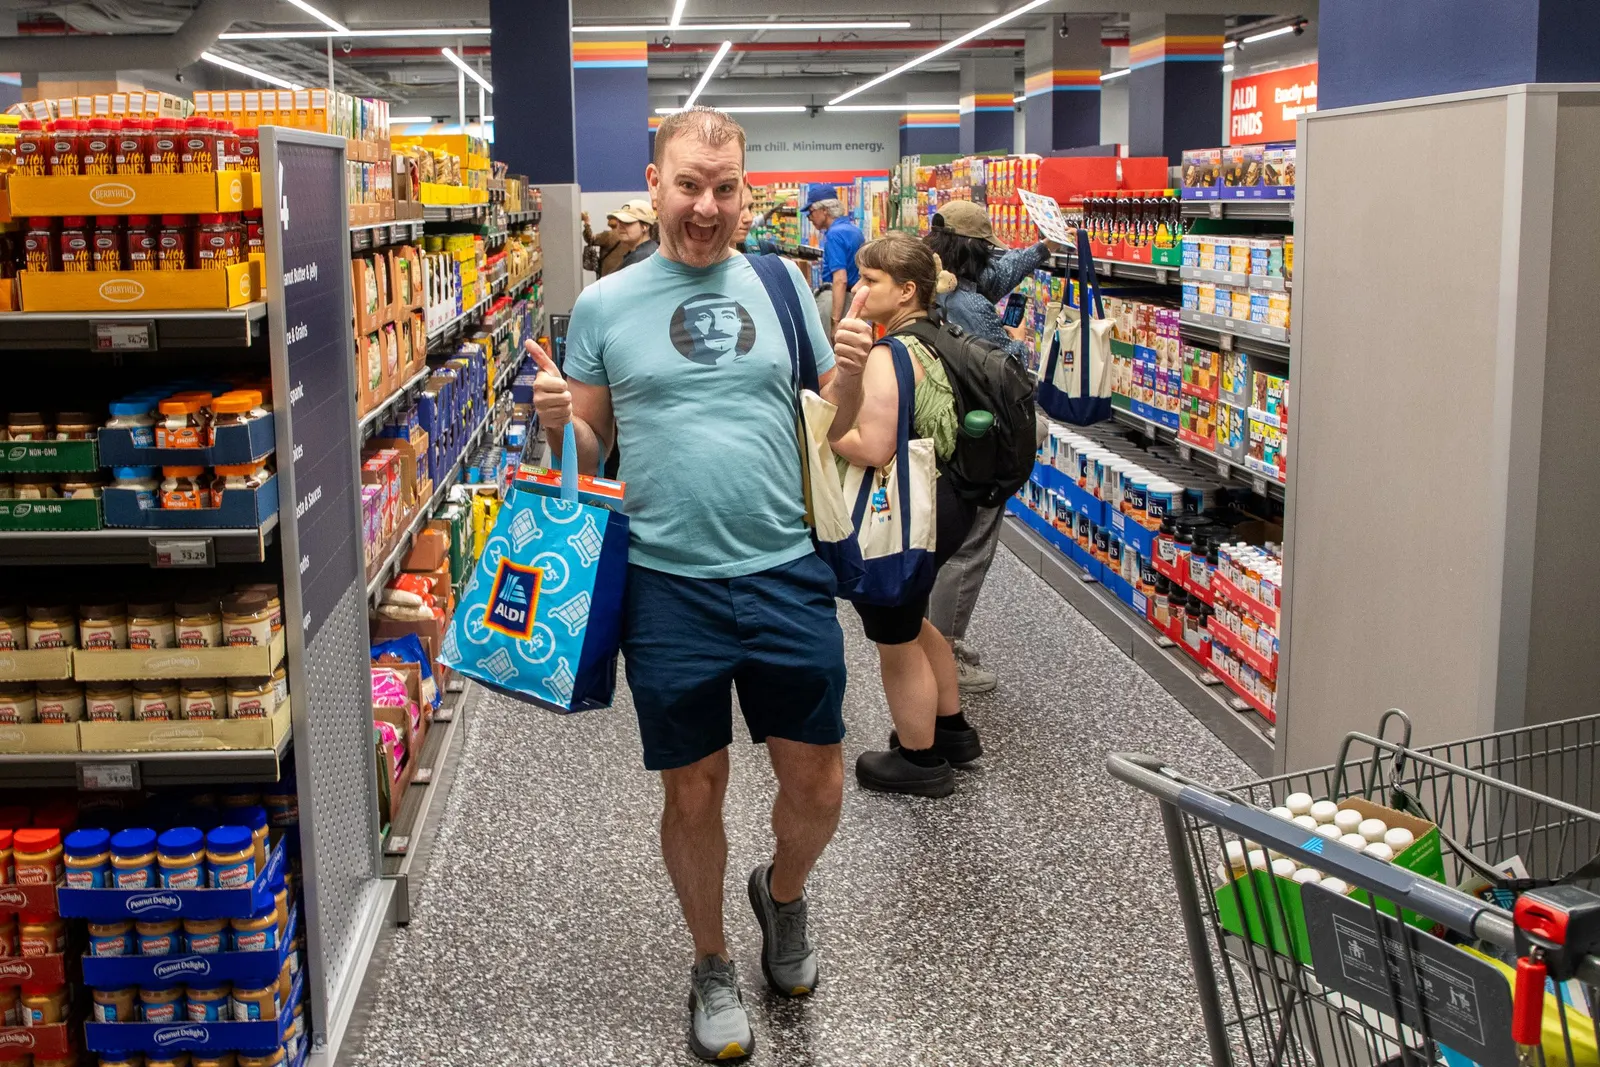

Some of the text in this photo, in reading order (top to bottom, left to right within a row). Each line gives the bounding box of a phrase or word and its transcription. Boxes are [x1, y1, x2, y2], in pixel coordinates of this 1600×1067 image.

[1232, 85, 1257, 111] ALDI
[1231, 111, 1263, 137] FINDS
[764, 142, 789, 152] chill.
[792, 141, 842, 151] Minimum
[845, 142, 885, 153] energy.
[192, 151, 212, 162] Hot
[95, 189, 130, 199] BERRYHILL
[63, 261, 89, 272] HONE
[95, 261, 120, 272] ONEY
[160, 260, 186, 271] ONEY
[294, 267, 306, 284] Butter
[309, 261, 318, 282] Jelly
[104, 285, 140, 295] BERRYHILL
[291, 327, 296, 344] &
[295, 321, 308, 341] Grains
[290, 380, 304, 407] spanic
[29, 448, 58, 456] NON-GMO
[304, 495, 309, 511] &
[308, 484, 322, 508] Sauces
[33, 505, 62, 513] NON-GMO
[182, 551, 205, 560] $3.29
[494, 602, 526, 624] ALDI
[130, 896, 178, 909] Peanut Delight
[3, 965, 28, 974] Delight
[158, 960, 206, 975] Peanut Delight
[6, 1033, 30, 1043] Delight
[158, 1027, 205, 1042] Peanut Delight
